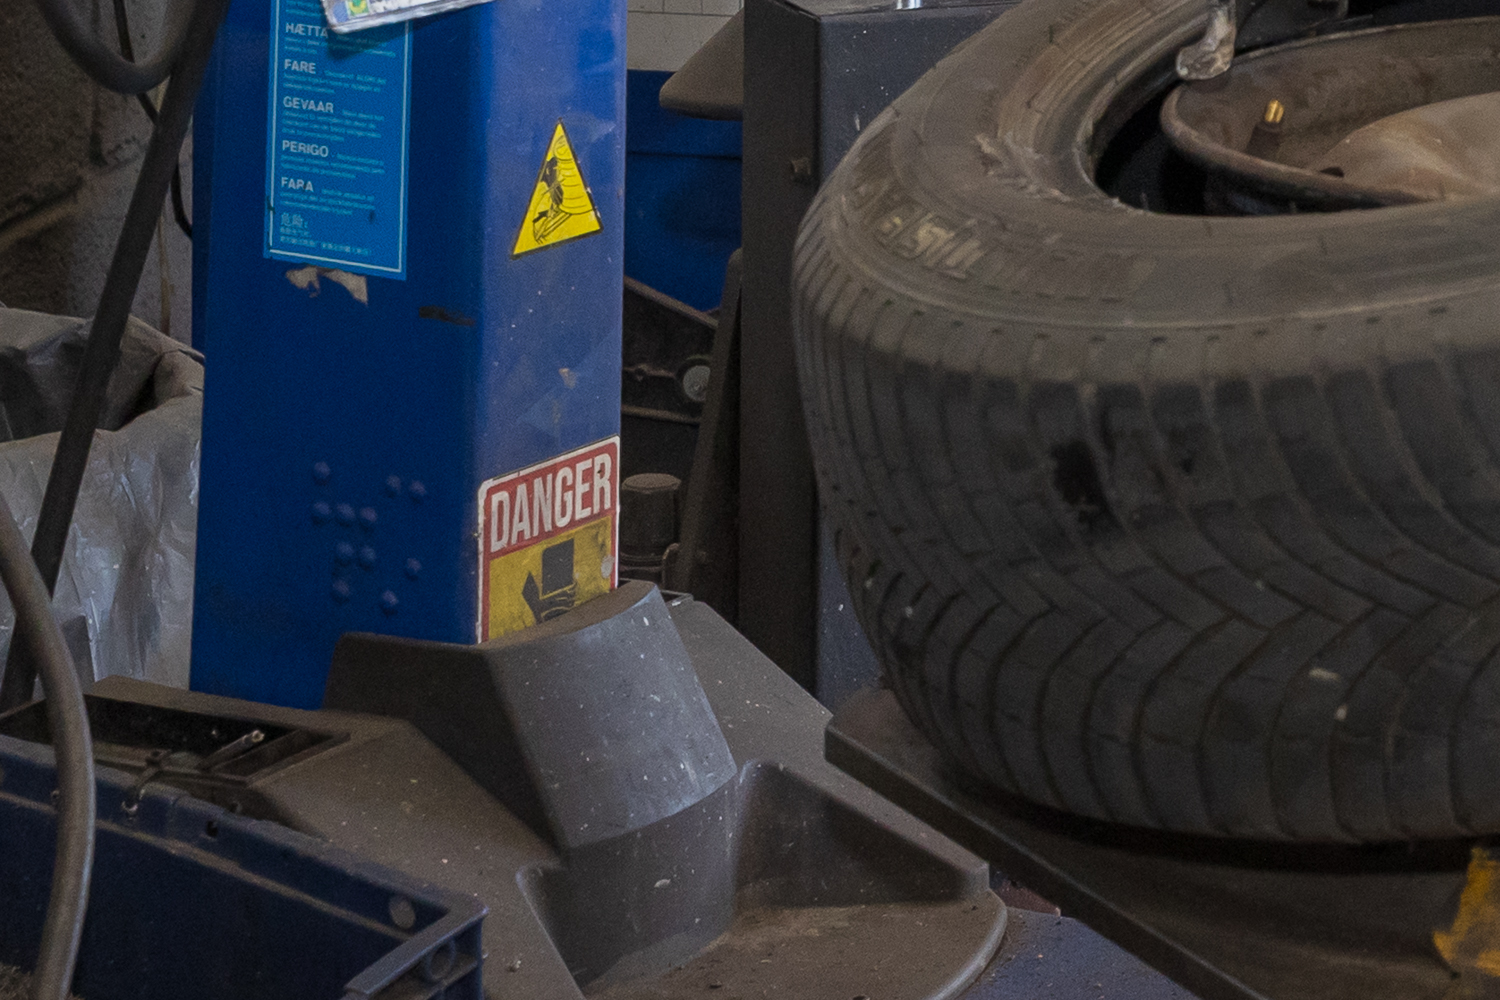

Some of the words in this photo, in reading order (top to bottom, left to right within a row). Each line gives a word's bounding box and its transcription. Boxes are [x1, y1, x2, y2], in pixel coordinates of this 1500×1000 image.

[284, 58, 316, 75] FARE
[283, 95, 334, 113] GEVAAR
[282, 139, 329, 158] PERIGO
[281, 176, 314, 192] FARA
[490, 452, 612, 553] DANGER
